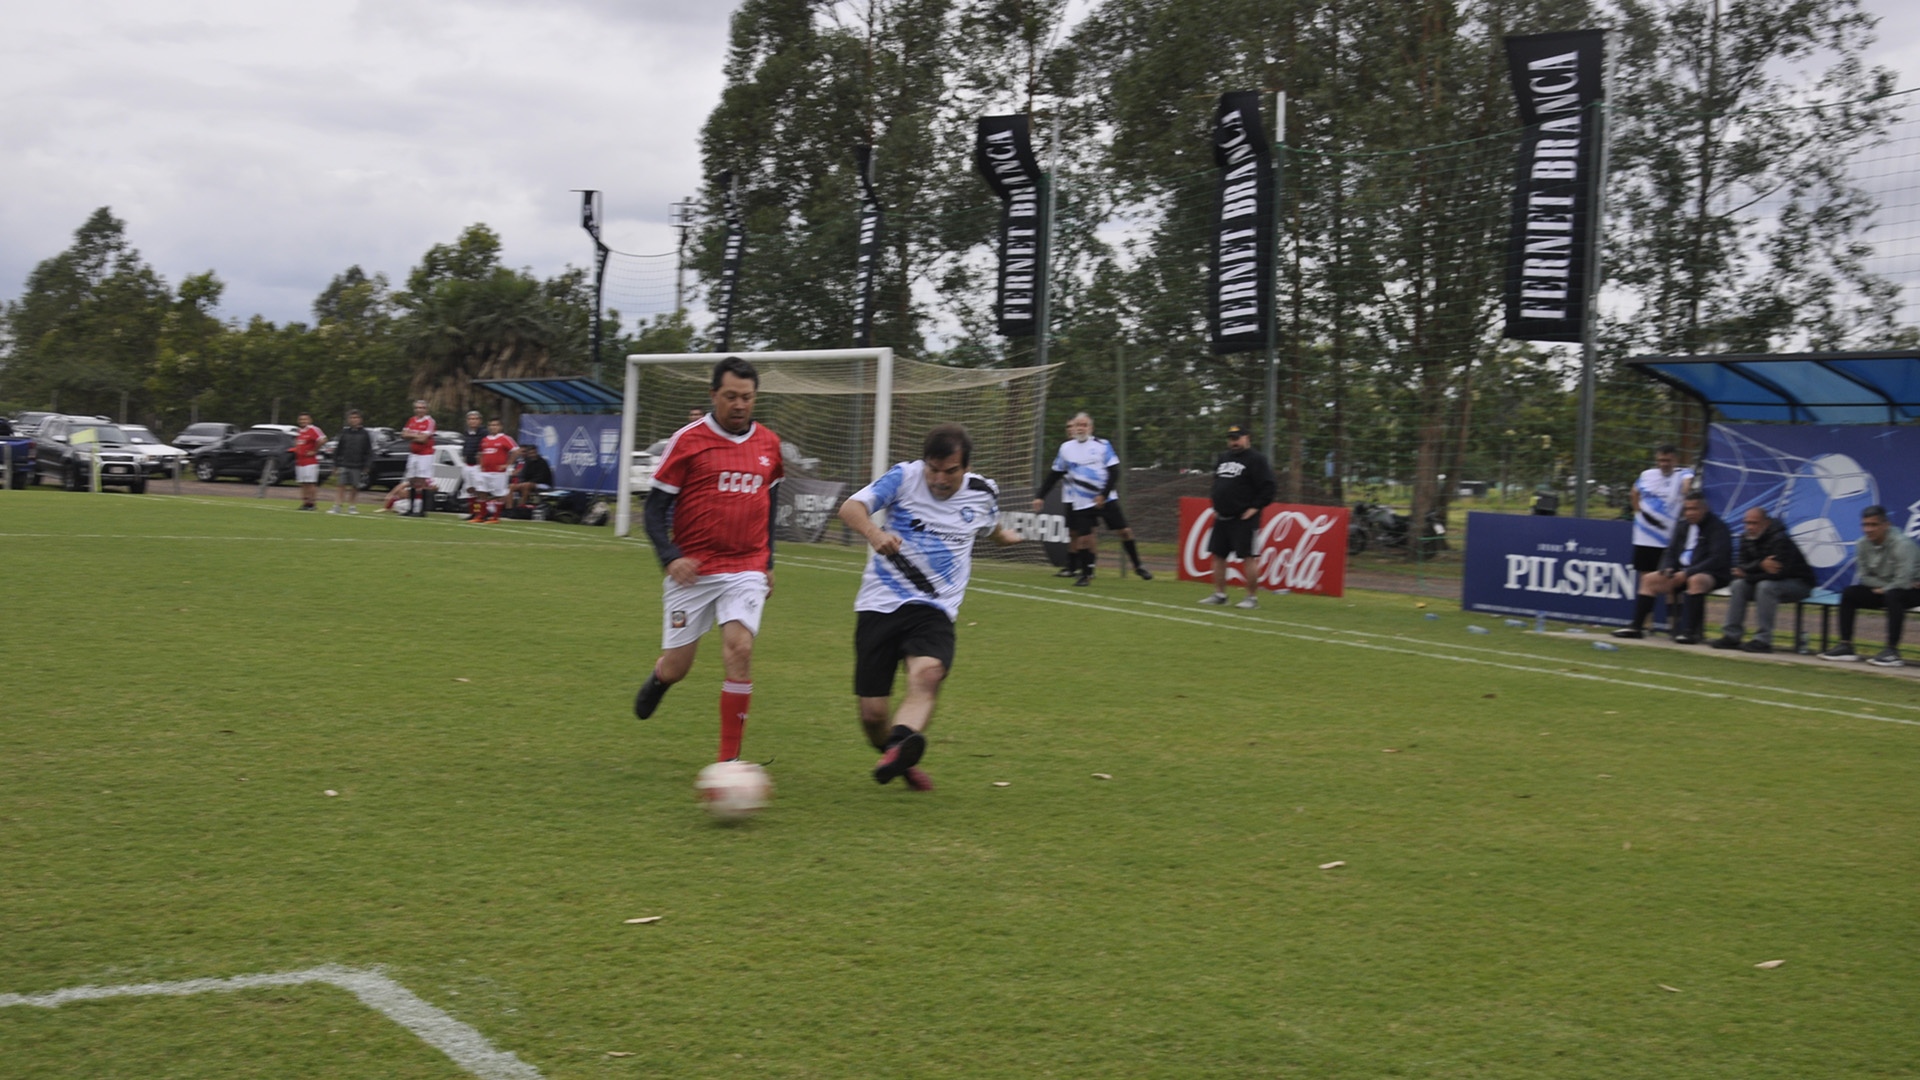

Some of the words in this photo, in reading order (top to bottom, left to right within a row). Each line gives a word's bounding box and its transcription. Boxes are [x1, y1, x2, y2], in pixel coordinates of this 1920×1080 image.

[1527, 50, 1582, 180] BRANCA
[985, 129, 1037, 218] BRANCA
[1002, 226, 1037, 320] FERNET
[1218, 226, 1260, 336] FERNET
[1519, 191, 1576, 319] FERNET
[718, 471, 764, 494] CCCP
[1183, 507, 1340, 590] CoCola
[1503, 553, 1637, 601] PILSEN
